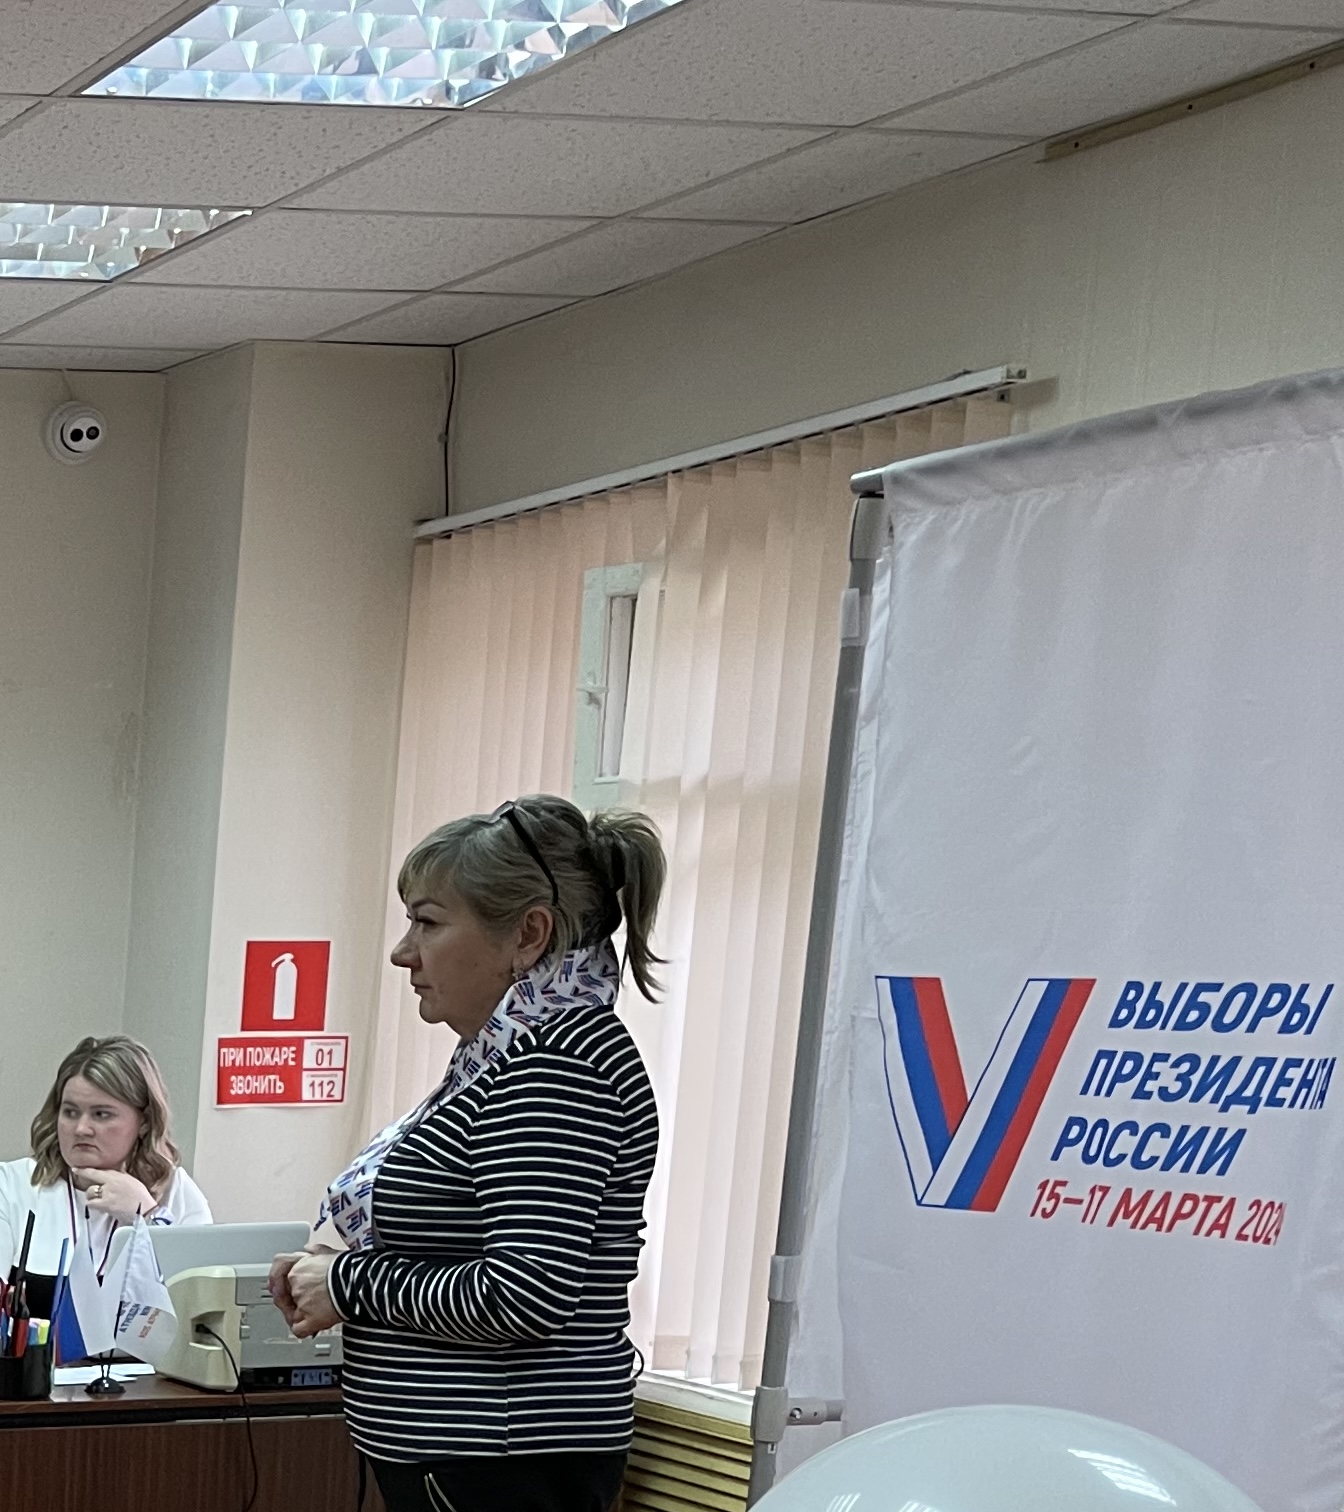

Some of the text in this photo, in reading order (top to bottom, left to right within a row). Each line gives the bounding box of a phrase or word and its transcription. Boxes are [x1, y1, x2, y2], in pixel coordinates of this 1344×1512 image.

[1108, 980, 1334, 1036] ВЫБОРЫ
[220, 1046, 297, 1067] ПРИ ПОЖАРЕ
[315, 1048, 334, 1067] 01
[230, 1075, 285, 1095] ЗВОНИТЬ
[308, 1079, 336, 1099] 112
[1050, 1116, 1247, 1177] РОССИИ
[1107, 1187, 1237, 1239] МАРТА
